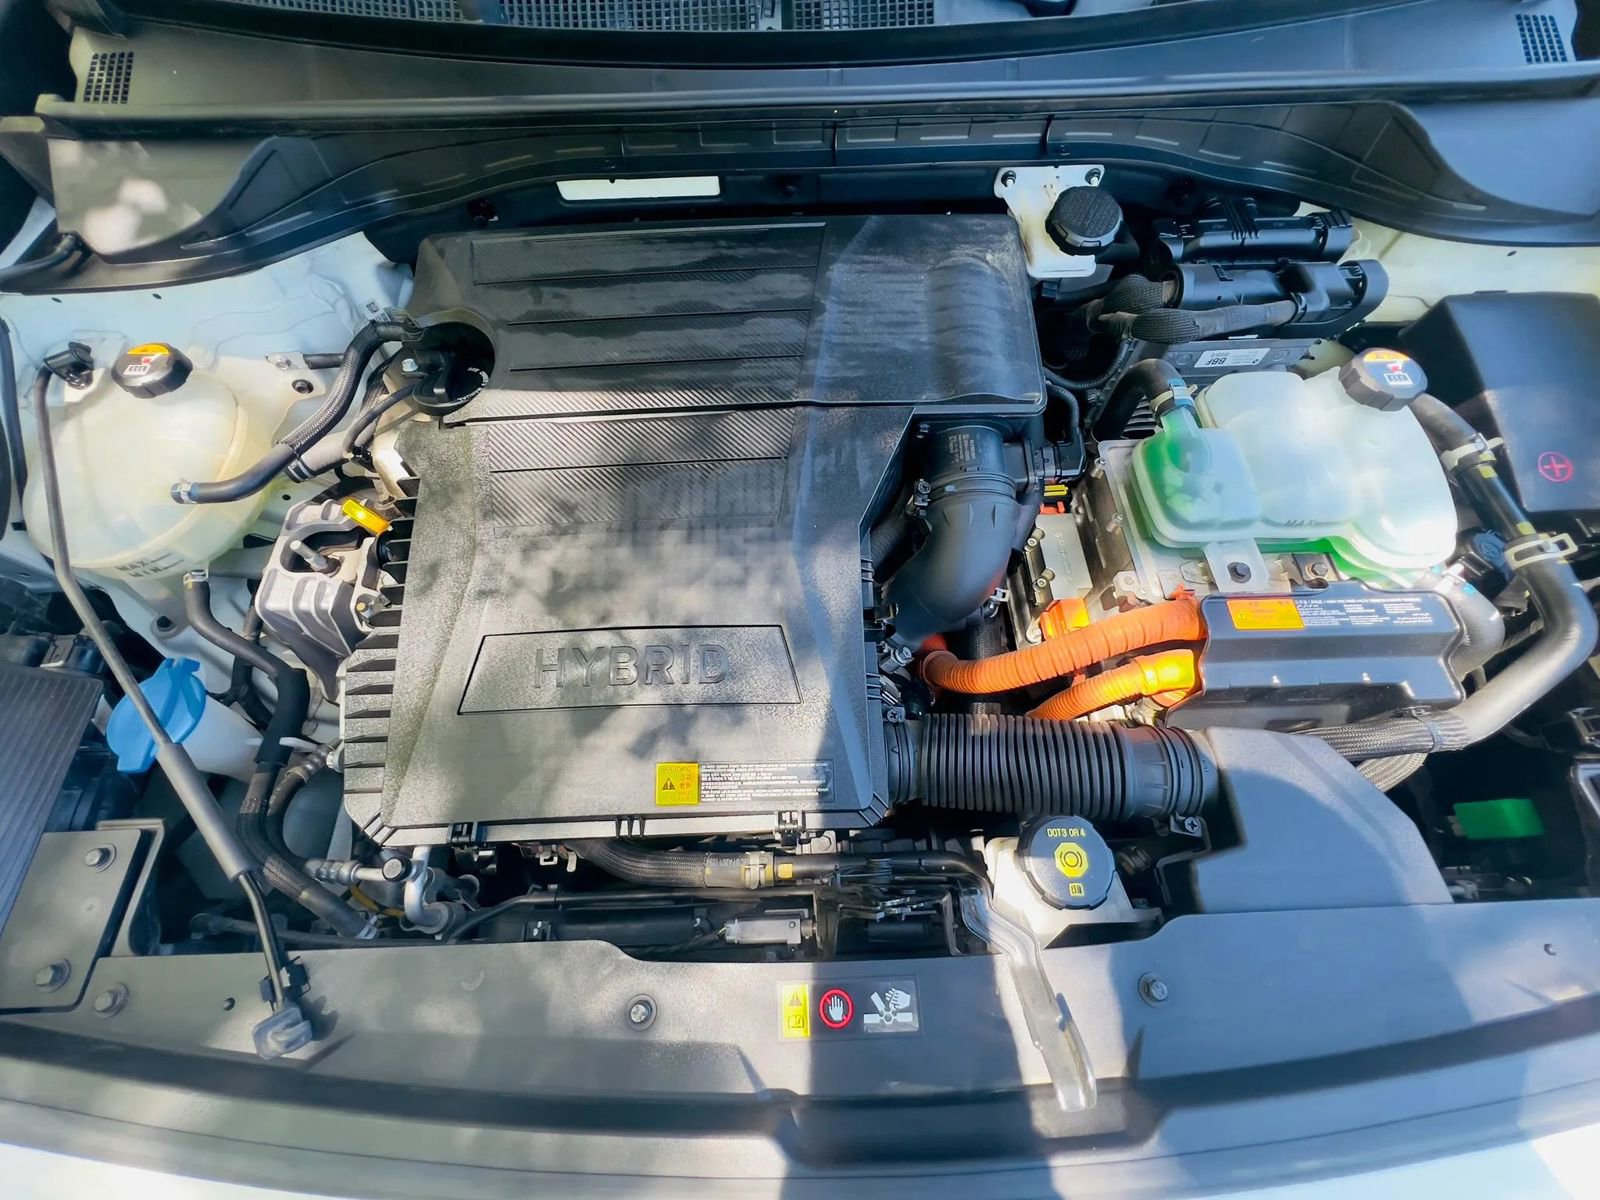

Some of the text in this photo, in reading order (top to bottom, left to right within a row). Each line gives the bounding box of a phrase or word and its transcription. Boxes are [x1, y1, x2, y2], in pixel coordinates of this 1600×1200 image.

[1284, 519, 1318, 528] MAX
[114, 560, 150, 572] MAX
[128, 566, 162, 578] MIN
[534, 644, 730, 689] HYBRID
[1068, 828, 1080, 838] OR
[1080, 828, 1087, 838] 4
